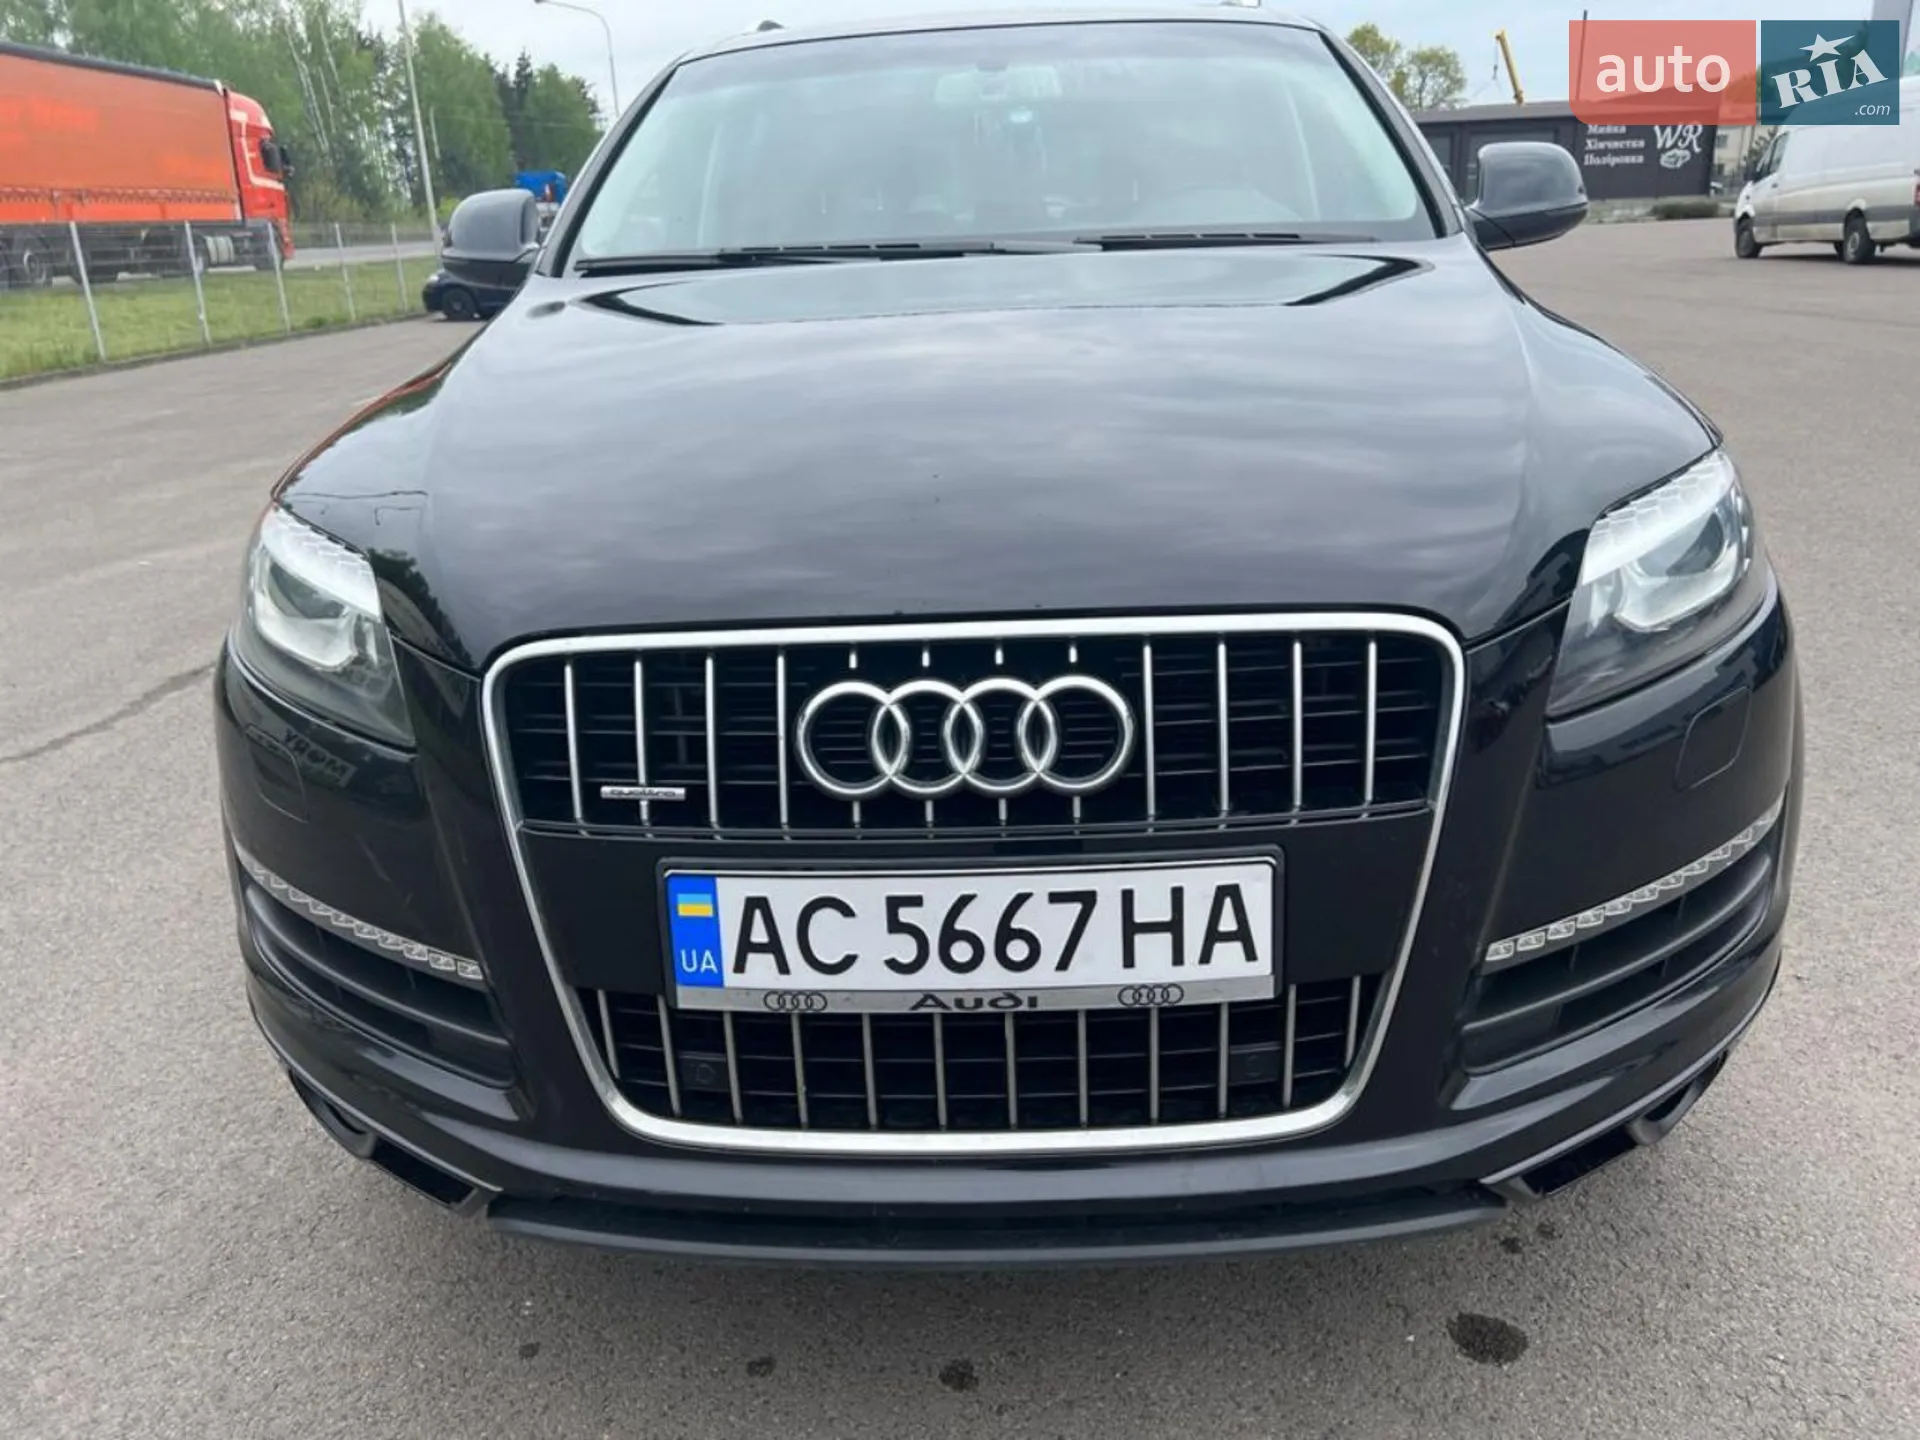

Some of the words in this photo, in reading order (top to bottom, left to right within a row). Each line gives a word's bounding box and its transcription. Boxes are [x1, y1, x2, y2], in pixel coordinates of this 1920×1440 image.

[732, 895, 860, 976] AC
[883, 891, 1098, 976] 5667
[1120, 883, 1259, 970] HA
[681, 949, 718, 974] UA
[909, 991, 1039, 1012] Audi
